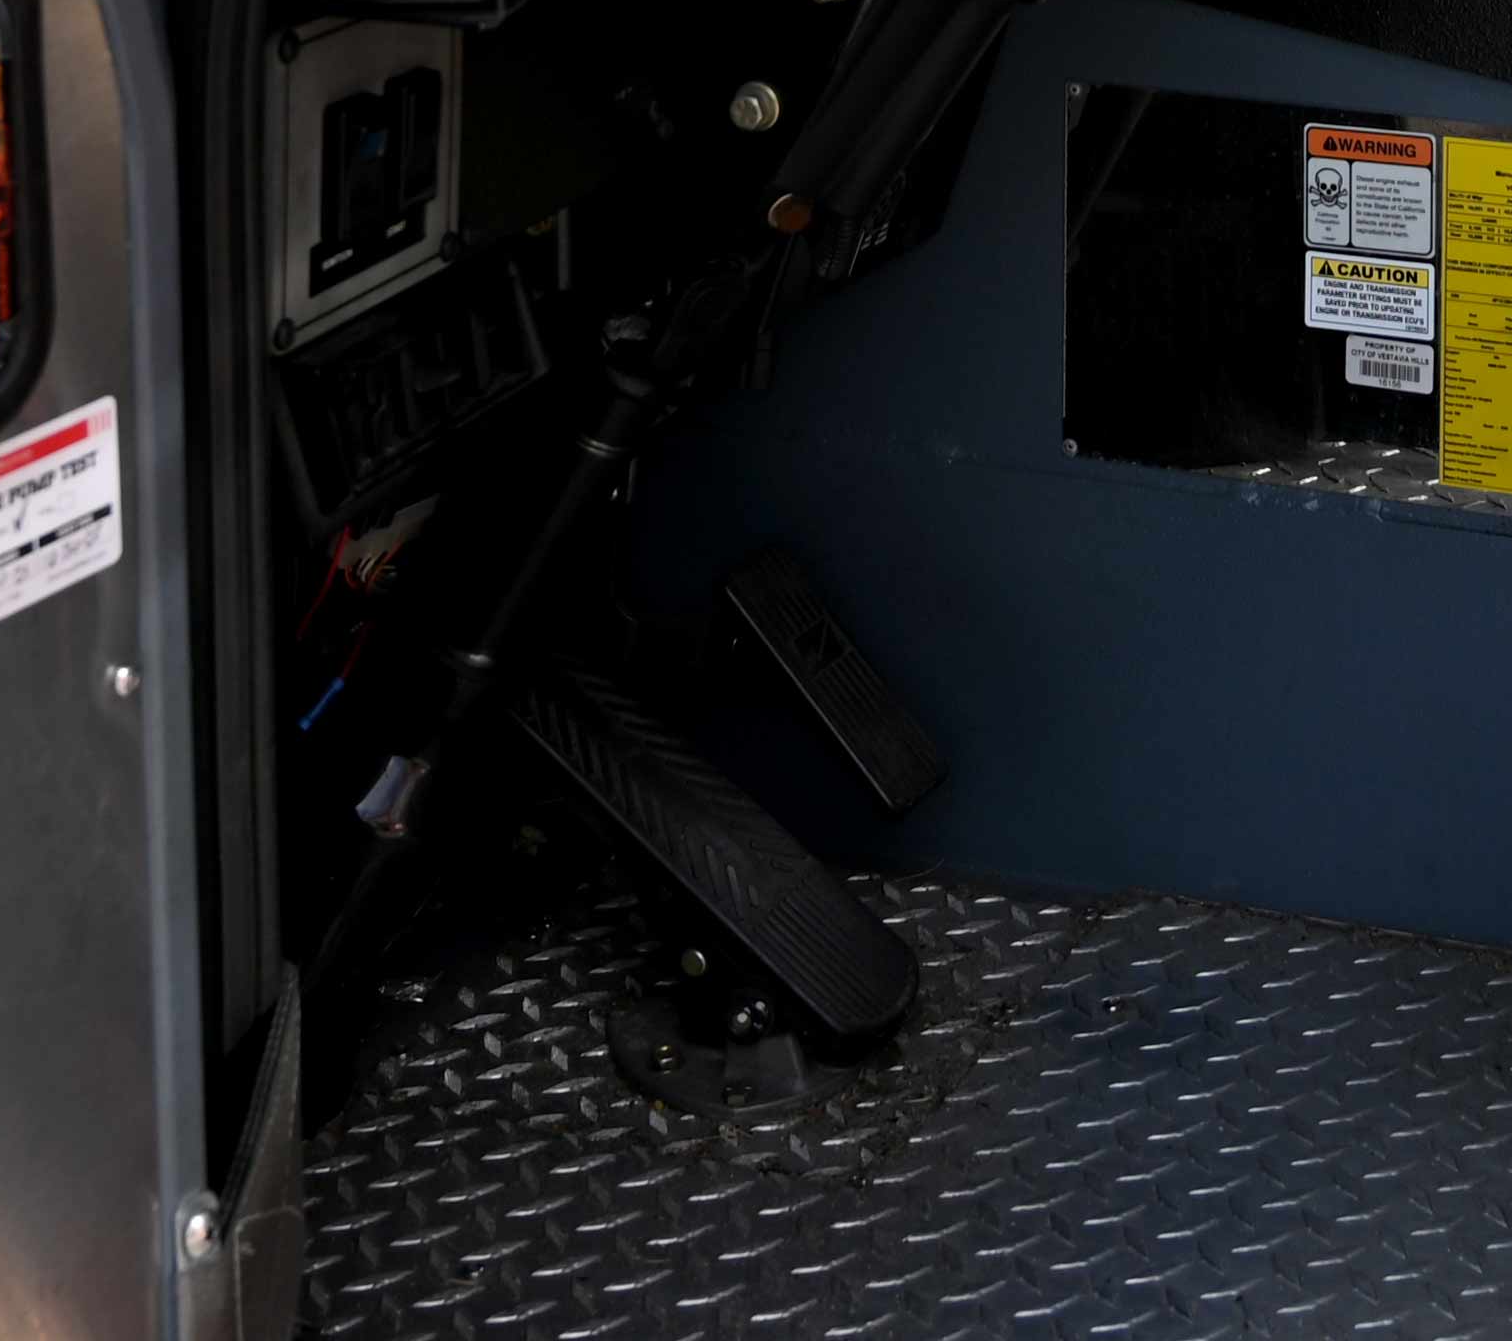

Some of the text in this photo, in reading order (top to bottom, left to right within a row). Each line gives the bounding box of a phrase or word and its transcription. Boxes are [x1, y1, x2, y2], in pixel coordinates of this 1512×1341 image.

[1338, 137, 1417, 158] WARNING
[1337, 263, 1418, 284] CAUTION
[1317, 288, 1423, 307] PARAMETER SETTINGS MUST BE
[1324, 280, 1417, 297] ENGINE AND TRANSMISSION
[1315, 306, 1425, 326] ENGINE OR TRANSMISSION ECU'S
[1325, 298, 1415, 315] SAVED PRIOR TO UPDATING
[1364, 340, 1416, 354] PROPERTY OF
[1351, 348, 1430, 366] CITY OF VESTAVIA HILLS
[8, 471, 56, 505] PUMP
[60, 449, 99, 481] TEST
